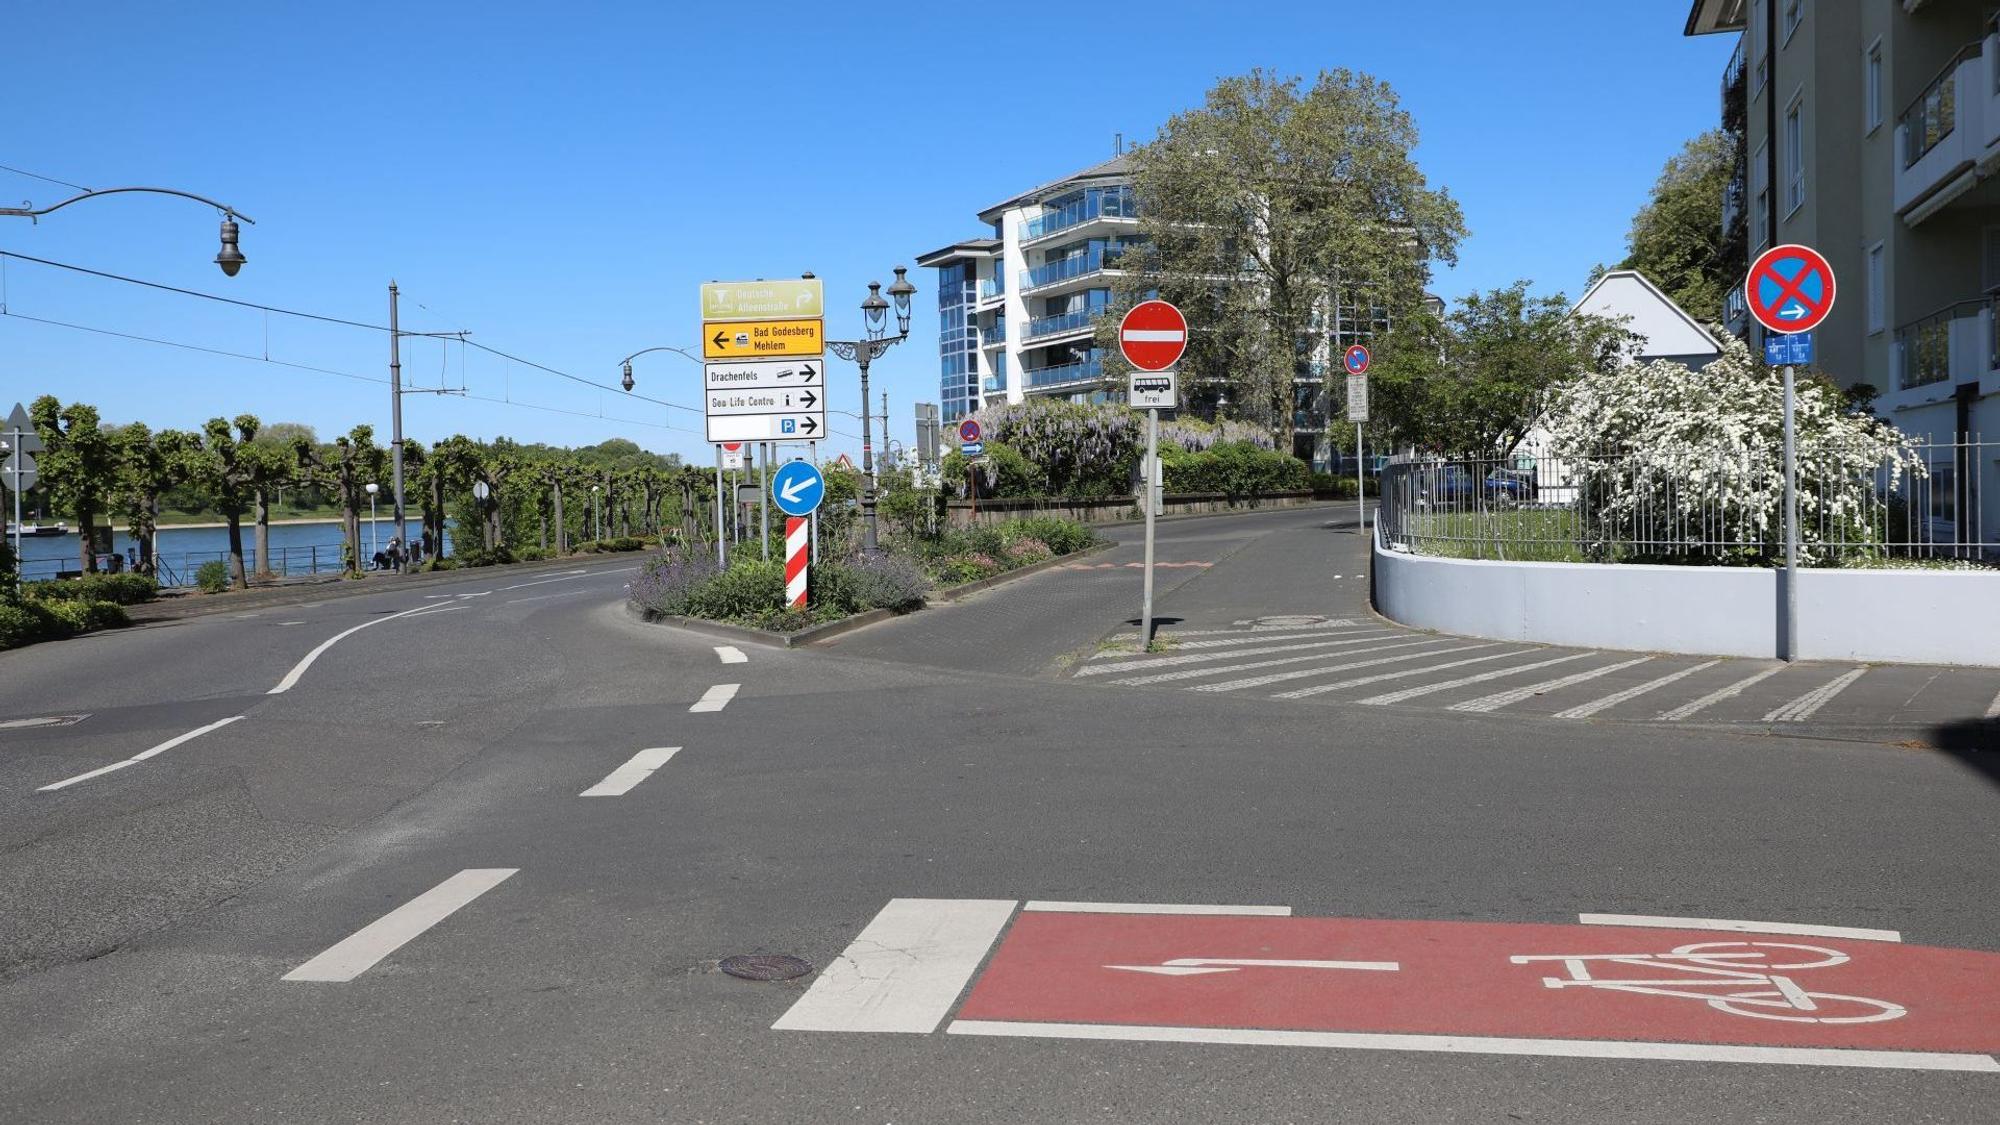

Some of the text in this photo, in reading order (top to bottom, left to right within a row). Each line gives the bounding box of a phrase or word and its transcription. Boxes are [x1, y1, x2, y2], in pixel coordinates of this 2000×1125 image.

[754, 326, 814, 337] Bad Godesberg
[754, 341, 786, 351] Mehlem
[711, 371, 758, 382] Drachenfels
[712, 396, 775, 408] Sea Life Centre
[1145, 395, 1160, 403] frei
